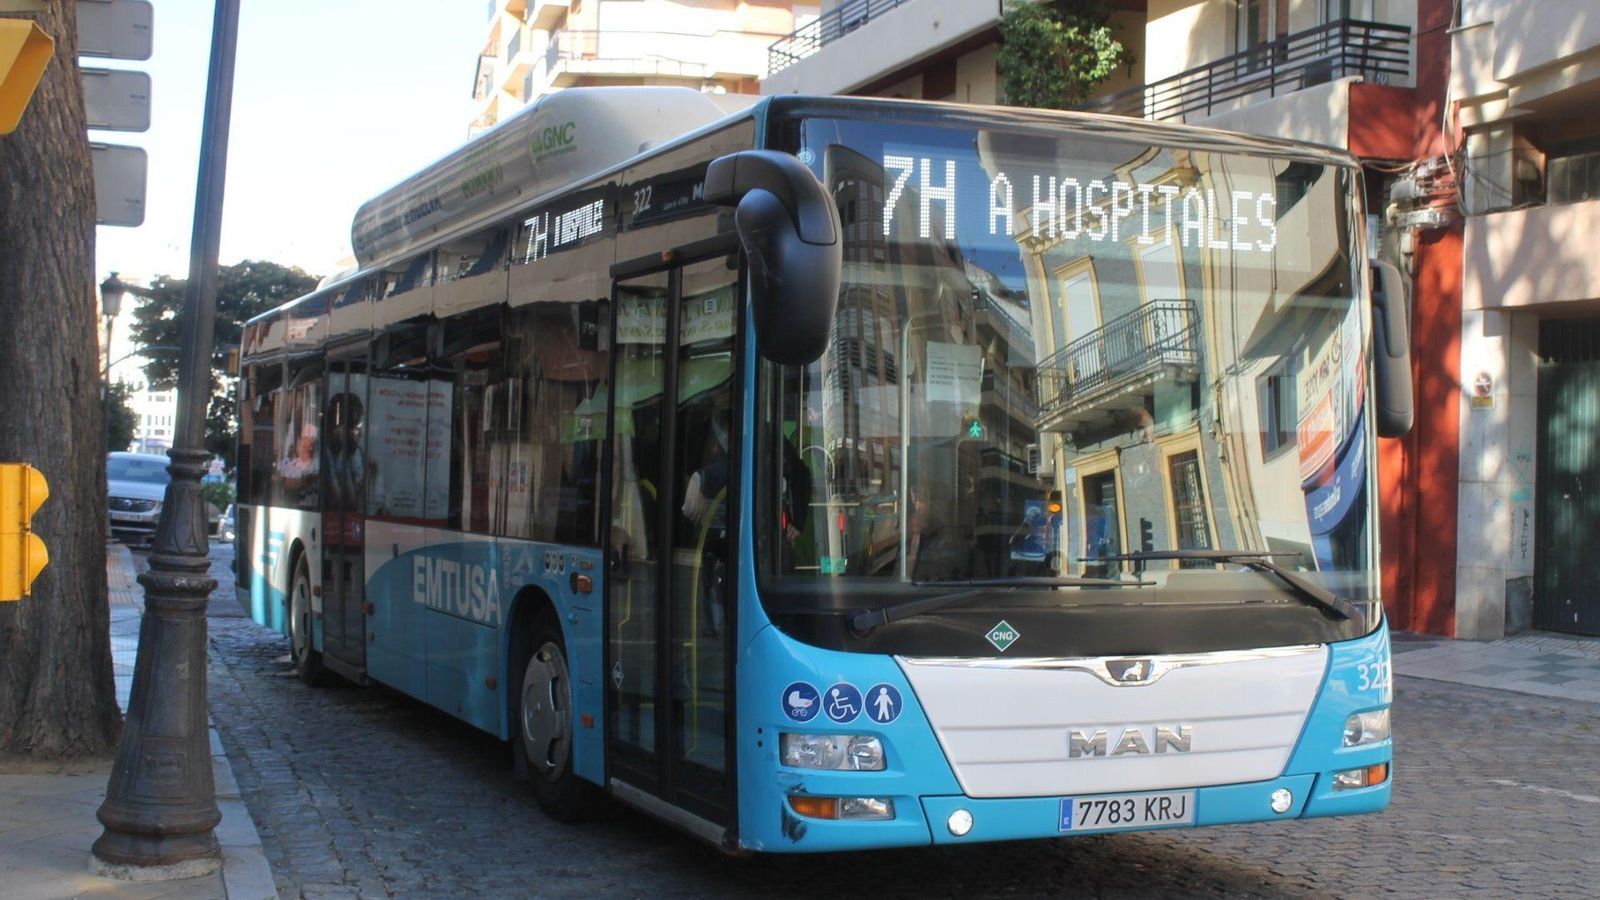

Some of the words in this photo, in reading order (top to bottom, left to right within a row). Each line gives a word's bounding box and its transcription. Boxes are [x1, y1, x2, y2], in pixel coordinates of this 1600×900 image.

[543, 121, 577, 150] GNC
[632, 185, 653, 217] 322
[883, 155, 956, 240] 7H
[989, 172, 1013, 236] A
[1032, 174, 1278, 252] HOSPITALES
[524, 211, 549, 265] 7H
[413, 555, 503, 625] EMTUSA
[992, 631, 1013, 641] CNG
[1068, 723, 1193, 758] MAN
[1079, 798, 1136, 826] 7783
[1144, 795, 1186, 822] KRJ
